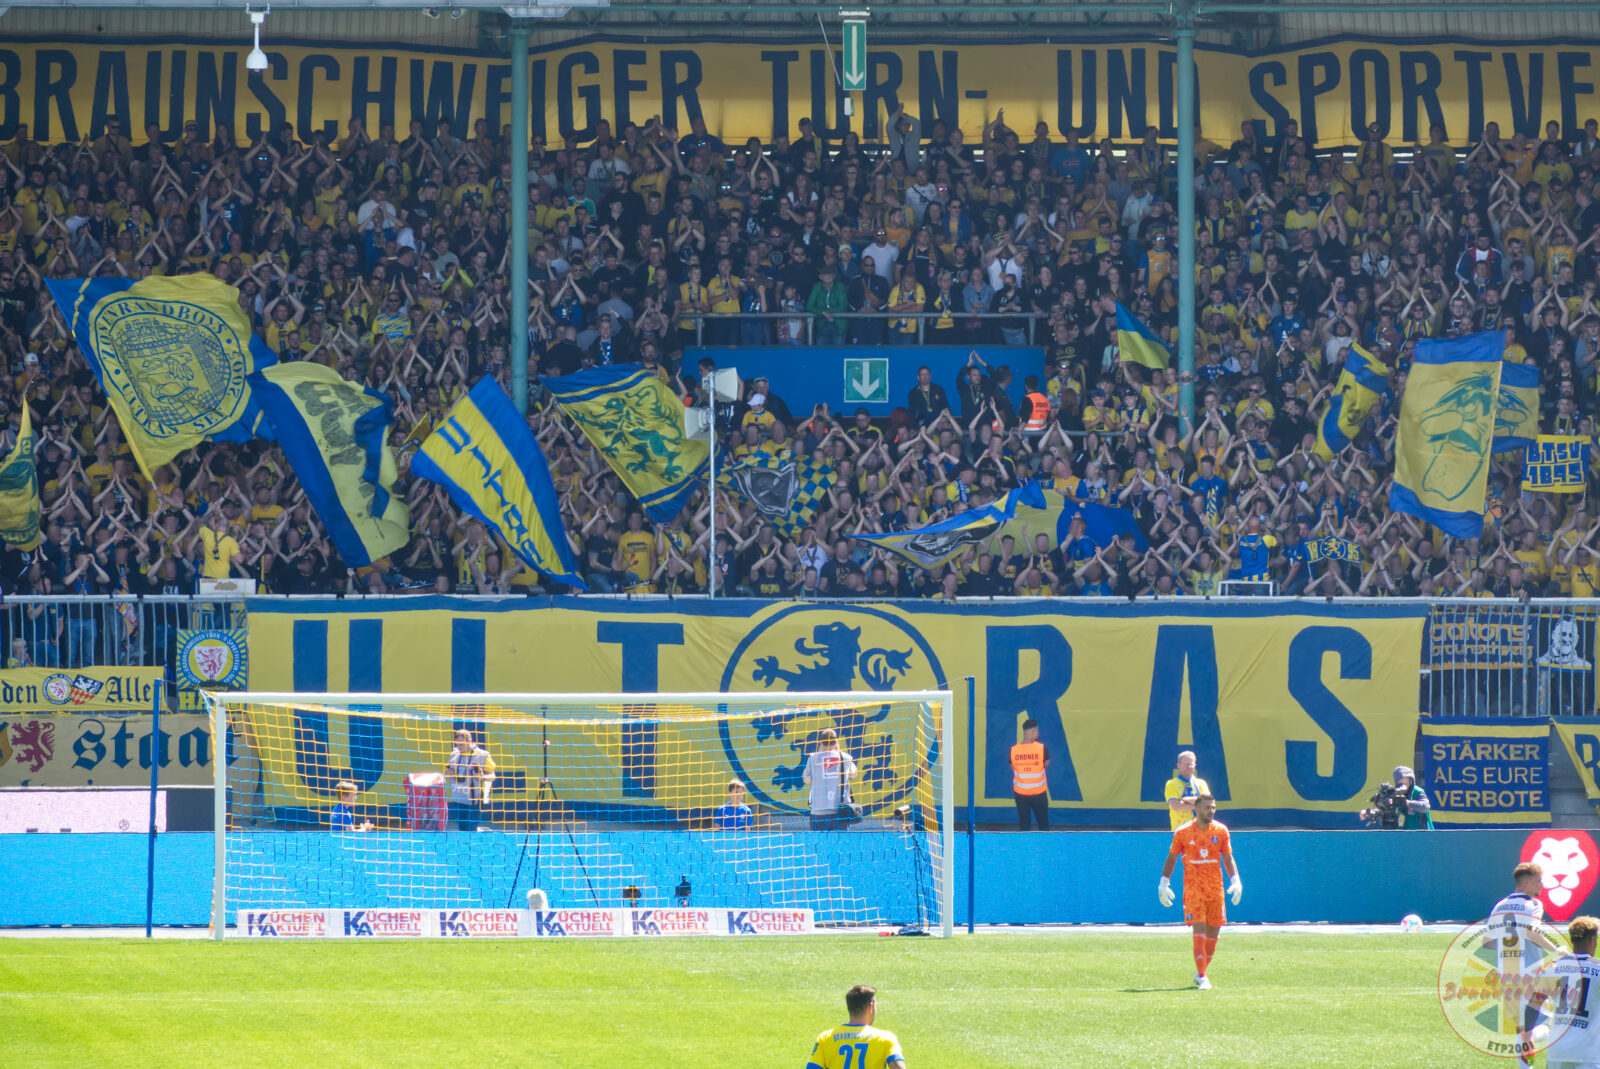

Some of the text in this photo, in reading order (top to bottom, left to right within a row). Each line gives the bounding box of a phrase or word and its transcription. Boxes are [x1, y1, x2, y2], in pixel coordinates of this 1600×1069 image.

[0, 49, 706, 144] BRAUNSCHWEIGER
[761, 50, 987, 142] TURN-
[1528, 442, 1582, 462] BTSV
[1528, 464, 1584, 485] 1895
[1432, 740, 1540, 761] STÄRKER
[1434, 767, 1543, 784] ALS EURE
[1435, 790, 1543, 808] VERBOTE
[344, 911, 421, 931] KÜCHEN
[356, 923, 421, 936] AKTUELL
[440, 911, 518, 931] KÜCHEN
[452, 923, 518, 936] AKTUELL
[536, 911, 613, 931] KÜCHEN
[548, 923, 613, 936] AKTUELL
[632, 911, 709, 931] KÜCHEN
[643, 923, 709, 936] AKTUELL
[728, 911, 805, 931] KÜCHEN
[739, 923, 805, 936] AKTUELL
[1503, 913, 1519, 947] 3
[1555, 976, 1590, 1018] 11
[838, 1043, 869, 1069] 27
